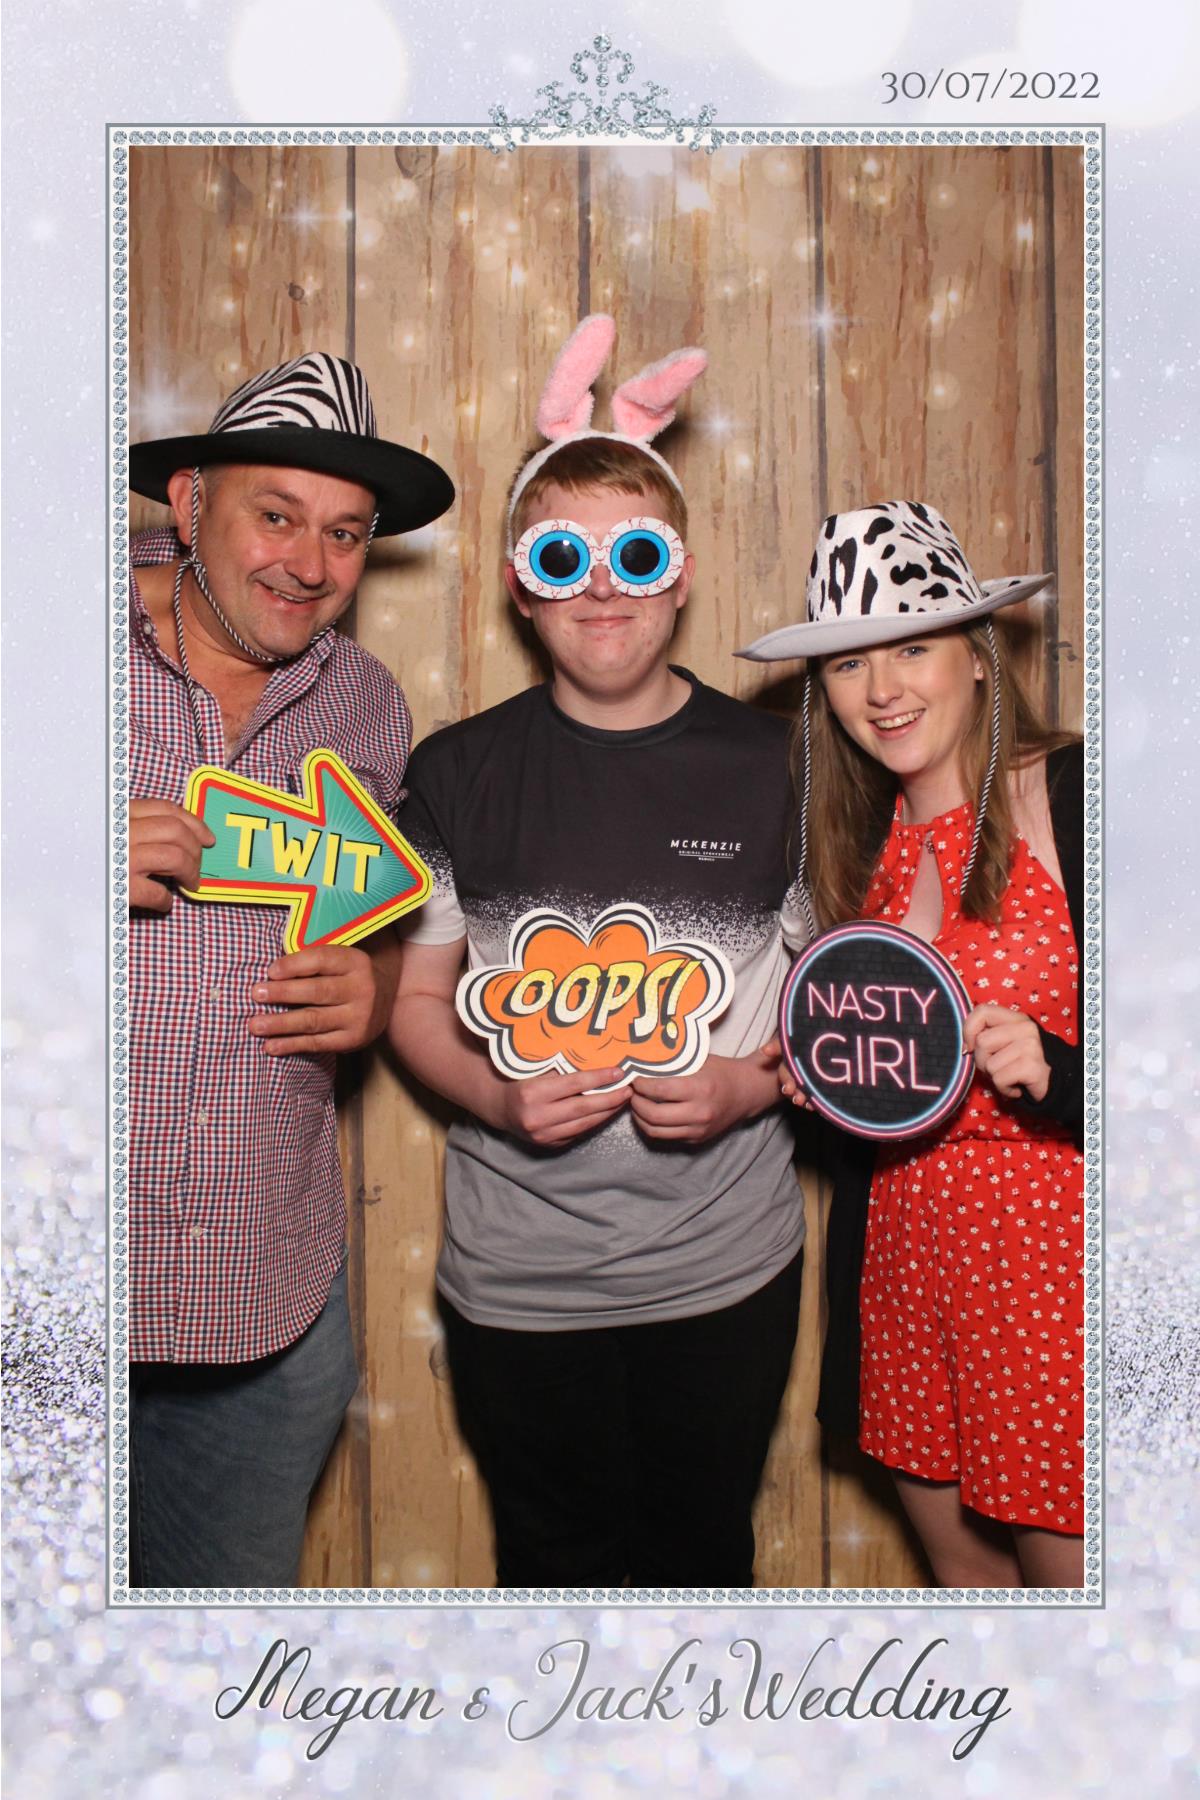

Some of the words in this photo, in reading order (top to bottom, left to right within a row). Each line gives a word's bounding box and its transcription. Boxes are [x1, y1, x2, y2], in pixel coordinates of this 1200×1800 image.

[225, 812, 383, 894] TWIT
[670, 839, 742, 851] MCKENZIE
[502, 957, 705, 1049] OOPS!
[807, 981, 937, 1025] NASTY
[811, 1033, 941, 1091] GIRL
